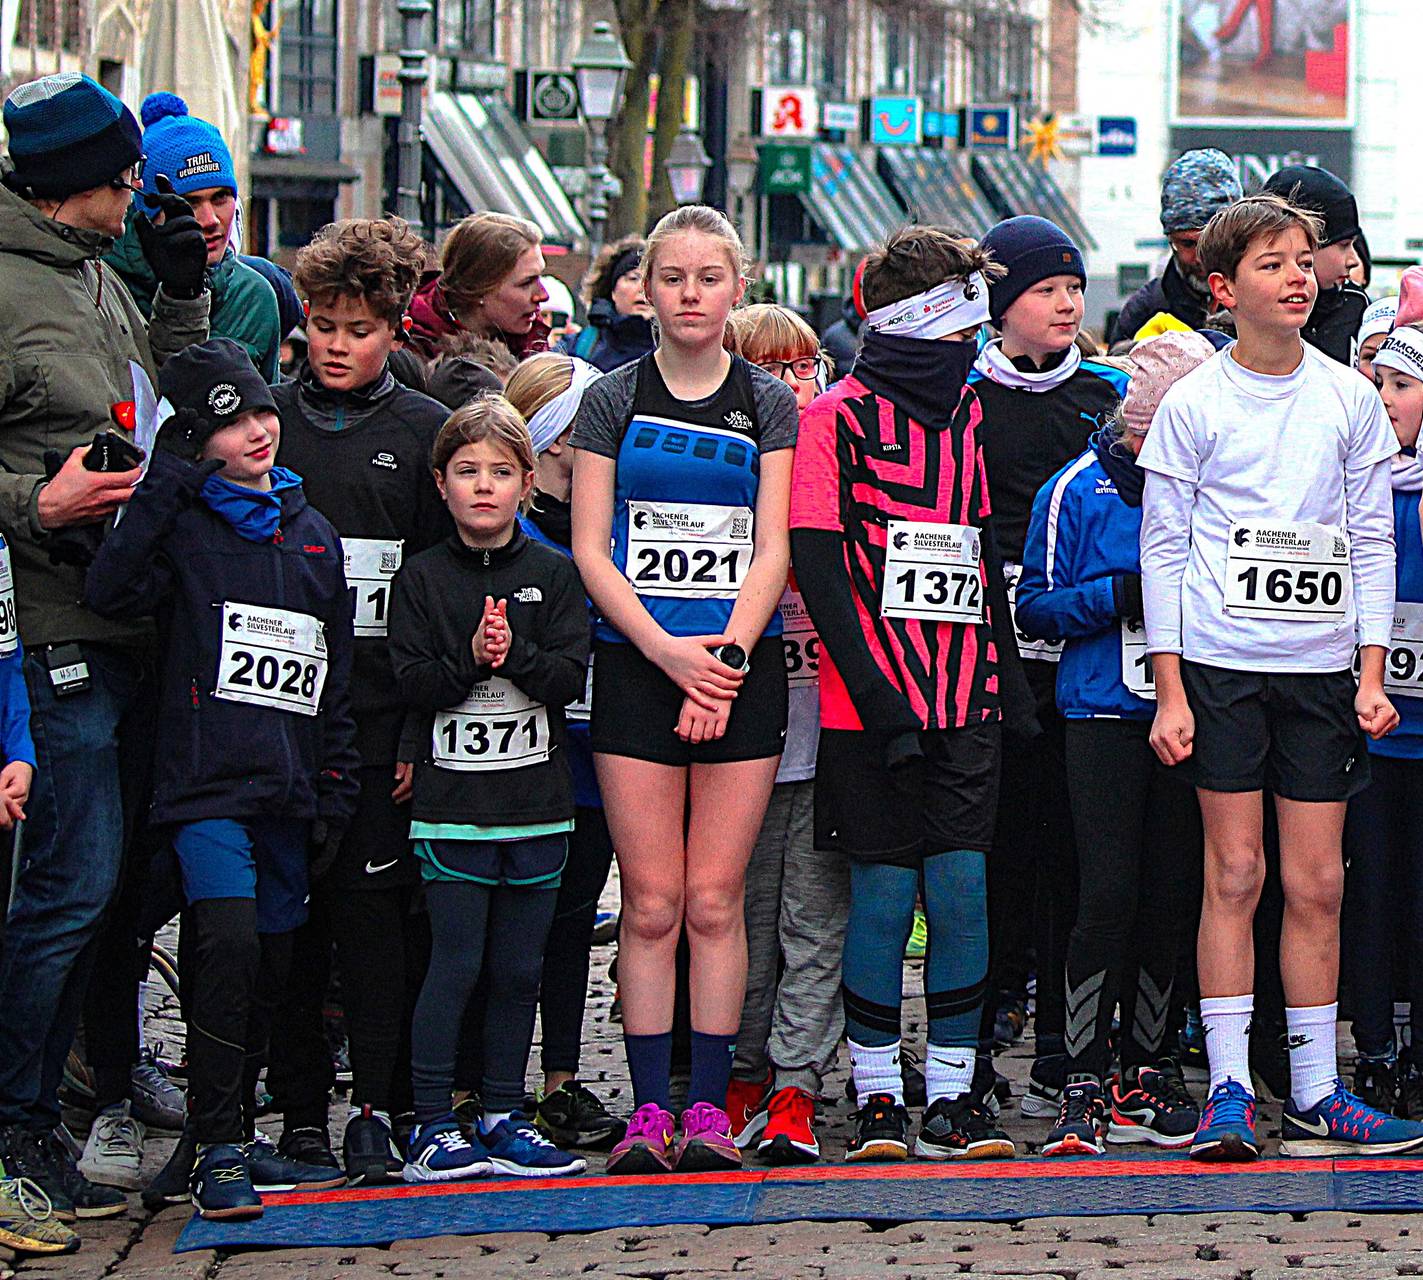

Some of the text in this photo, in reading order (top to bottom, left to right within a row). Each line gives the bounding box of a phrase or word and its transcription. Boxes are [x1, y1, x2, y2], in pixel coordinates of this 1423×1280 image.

[187, 153, 213, 167] TRAIL
[888, 314, 904, 326] AOK
[882, 443, 902, 452] KIPSTA
[652, 511, 689, 521] AACHENER
[652, 518, 705, 529] SILVESTERLAUF
[914, 531, 952, 541] AACHENER
[1256, 529, 1297, 539] AACHENER
[914, 538, 962, 549] SILVESTERLAUF
[1255, 536, 1311, 547] SILVESTERLAUF
[635, 548, 740, 583] 2021
[896, 568, 980, 608] 1372
[1238, 566, 1342, 606] 1650
[247, 615, 283, 627] AACHENER
[247, 622, 296, 636] SILVESTERLAUF
[228, 650, 318, 699] 2028
[442, 715, 539, 756] 1371
